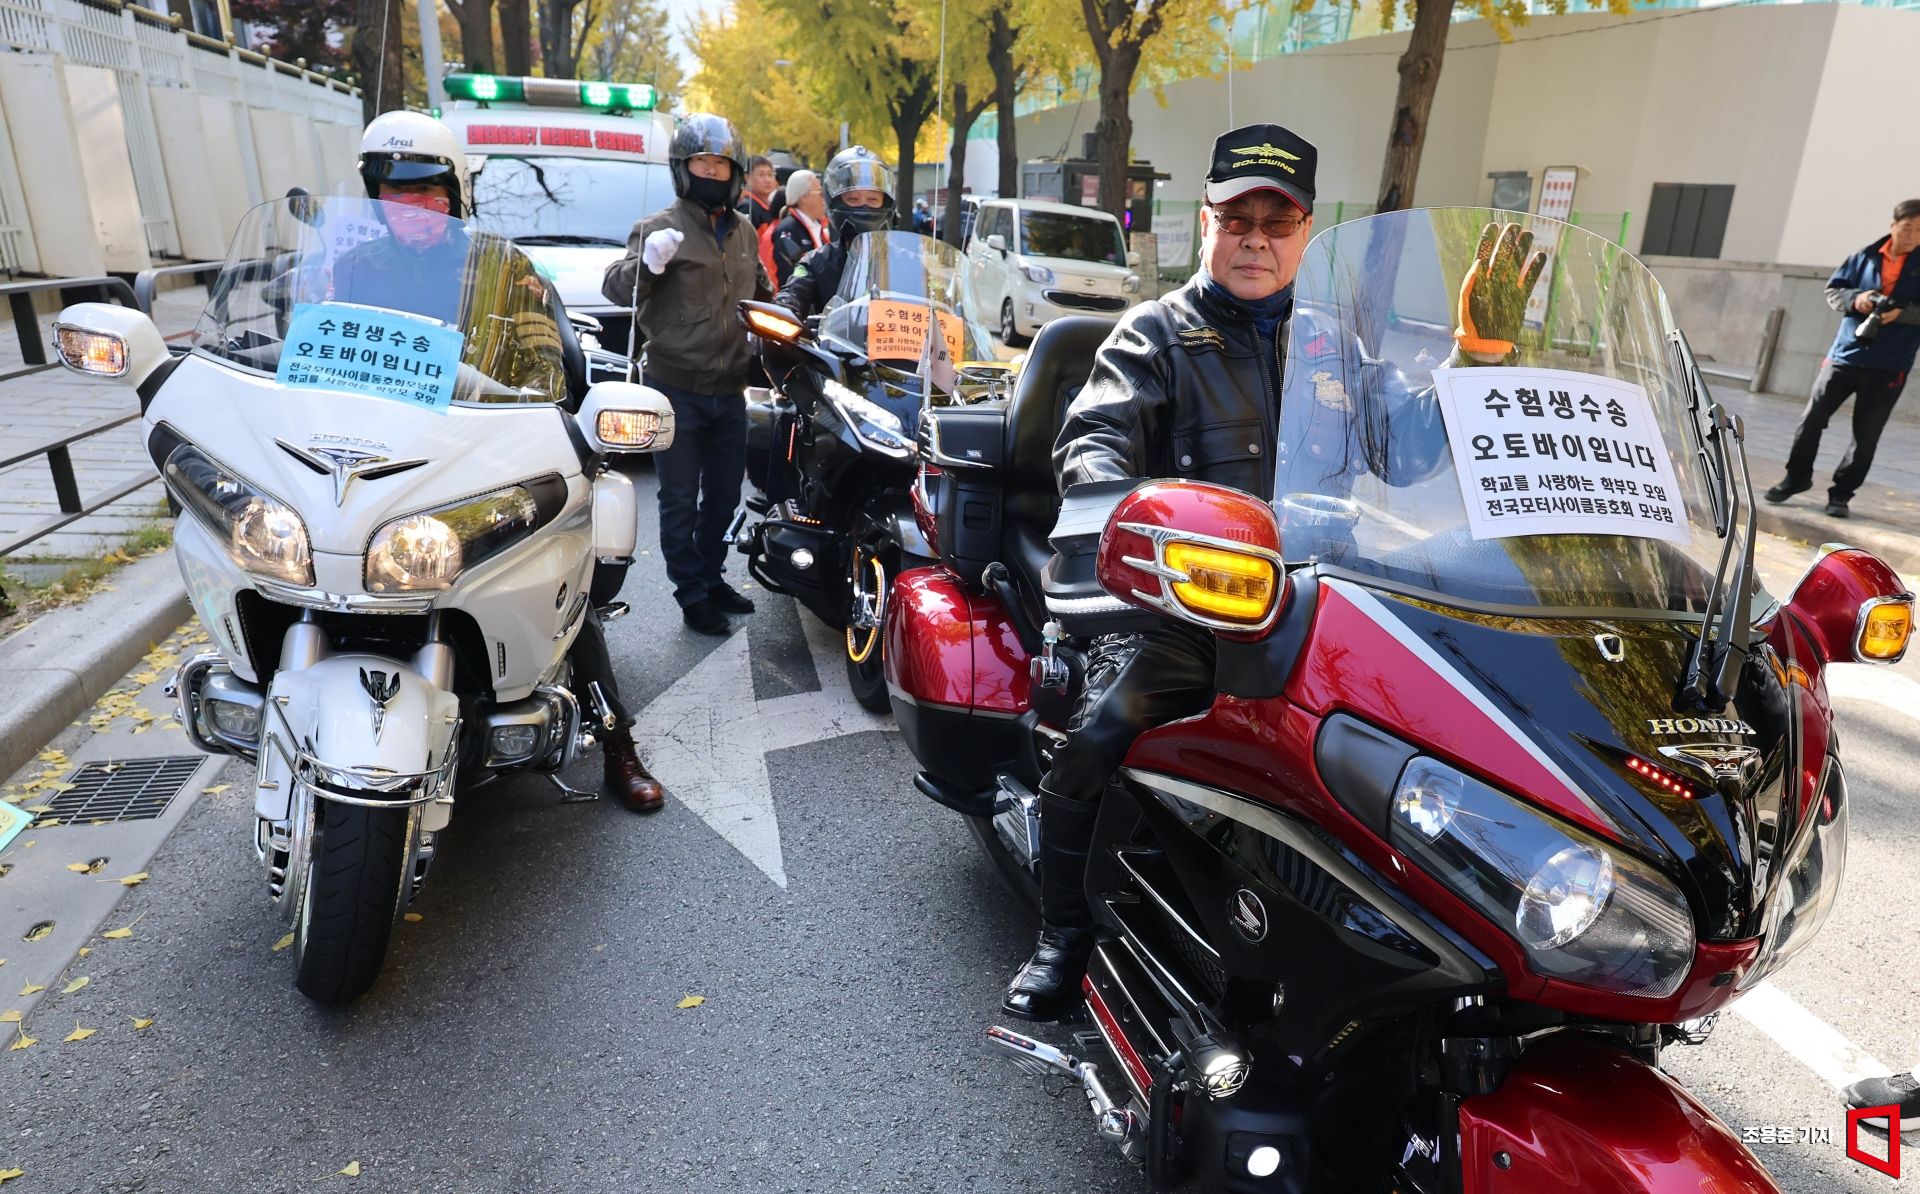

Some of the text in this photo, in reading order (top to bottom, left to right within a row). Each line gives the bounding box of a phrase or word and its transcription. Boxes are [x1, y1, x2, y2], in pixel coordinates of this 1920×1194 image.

[382, 136, 414, 147] Arai
[467, 125, 644, 153] EMERGENCY MEDICAL SERVICE
[1232, 158, 1296, 175] GOLDWING
[318, 319, 431, 353] 수험생수송
[876, 322, 956, 347] 오토바이다
[296, 342, 443, 380] 오토바이입니다
[287, 374, 319, 384] 학교를
[413, 391, 436, 406] 모임
[1484, 387, 1628, 428] 수험생수송
[1472, 433, 1657, 473] 오토바이입니다
[1480, 475, 1668, 502] 학교를 사랑하는 학부모 모임
[1486, 496, 1674, 524] 전국모터사이클동호회 모닝캄
[1647, 717, 1757, 735] HONDA
